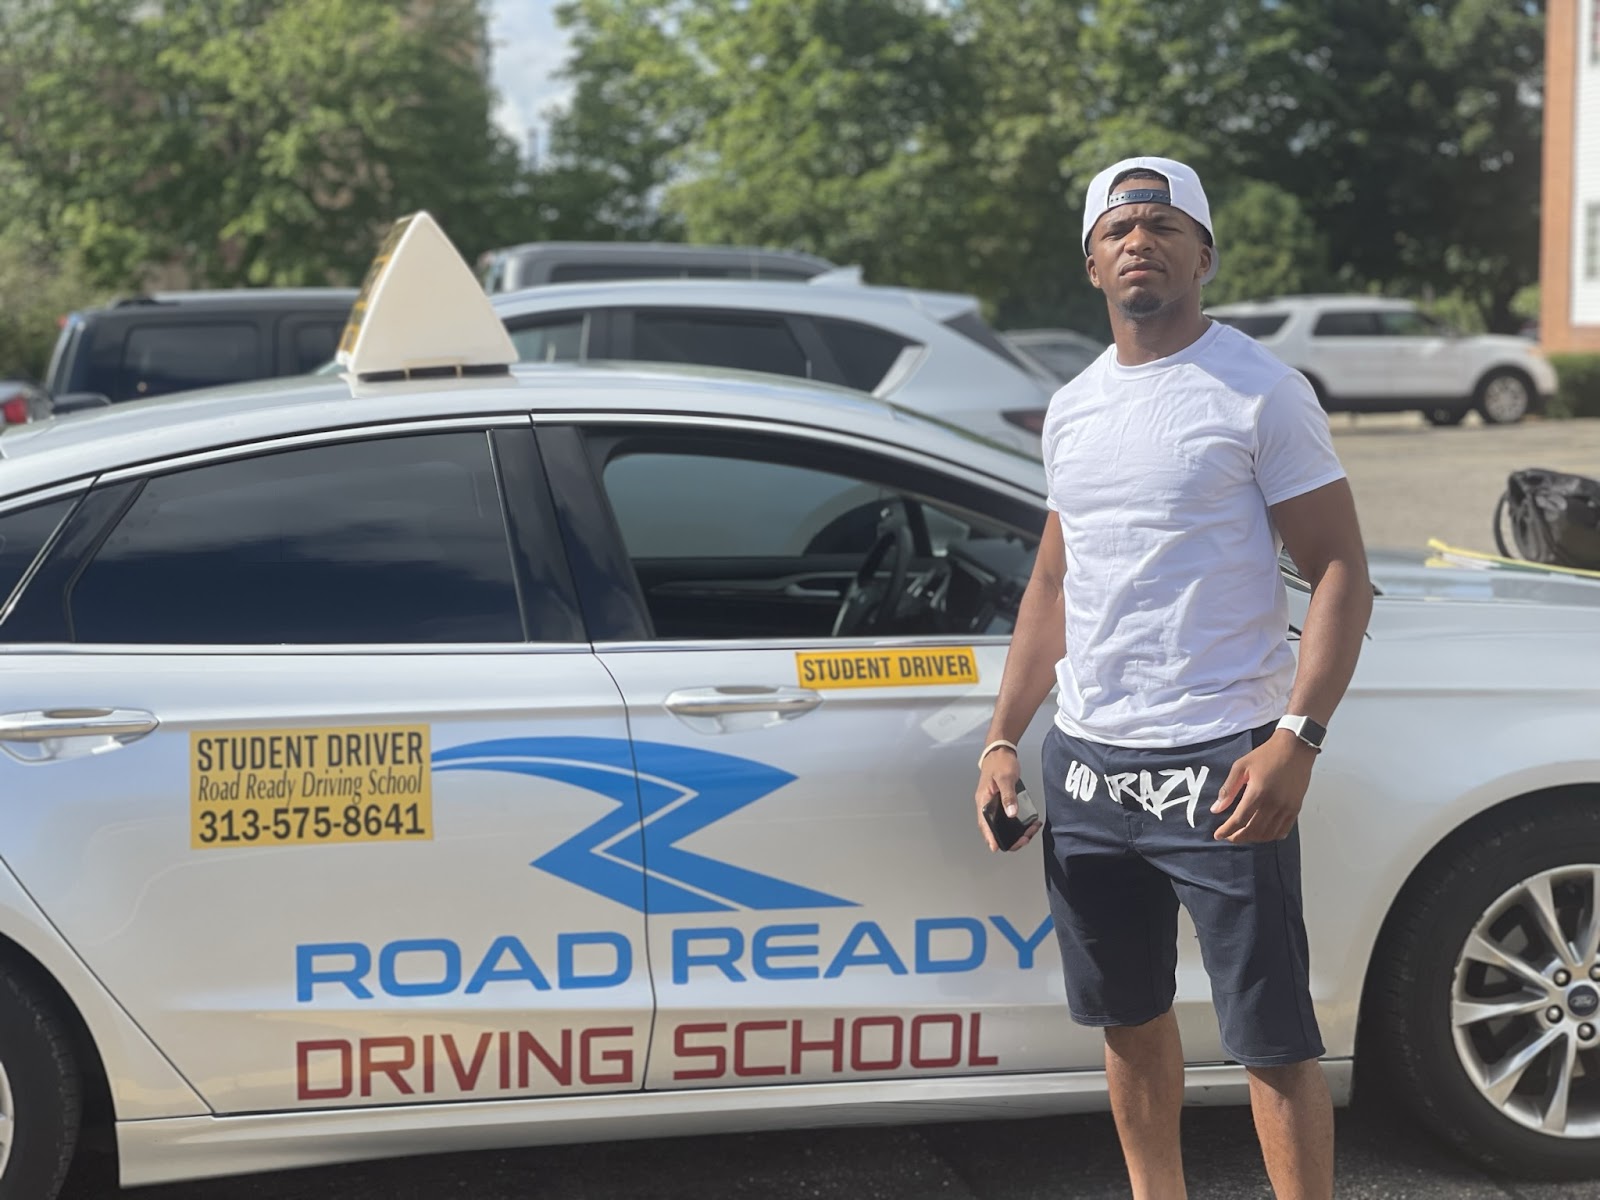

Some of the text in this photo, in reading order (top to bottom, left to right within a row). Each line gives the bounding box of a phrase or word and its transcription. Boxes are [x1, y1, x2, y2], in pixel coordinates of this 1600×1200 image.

[804, 655, 972, 681] STUDENT DRIVER
[197, 732, 423, 771] STUDENT DRIVER
[198, 766, 423, 806] Road Ready Driving School
[1104, 765, 1210, 828] RAZY
[199, 803, 425, 843] 313-575-8641
[296, 914, 1053, 1003] ROAD READY
[296, 1012, 998, 1101] DRIVING SCHOOL
